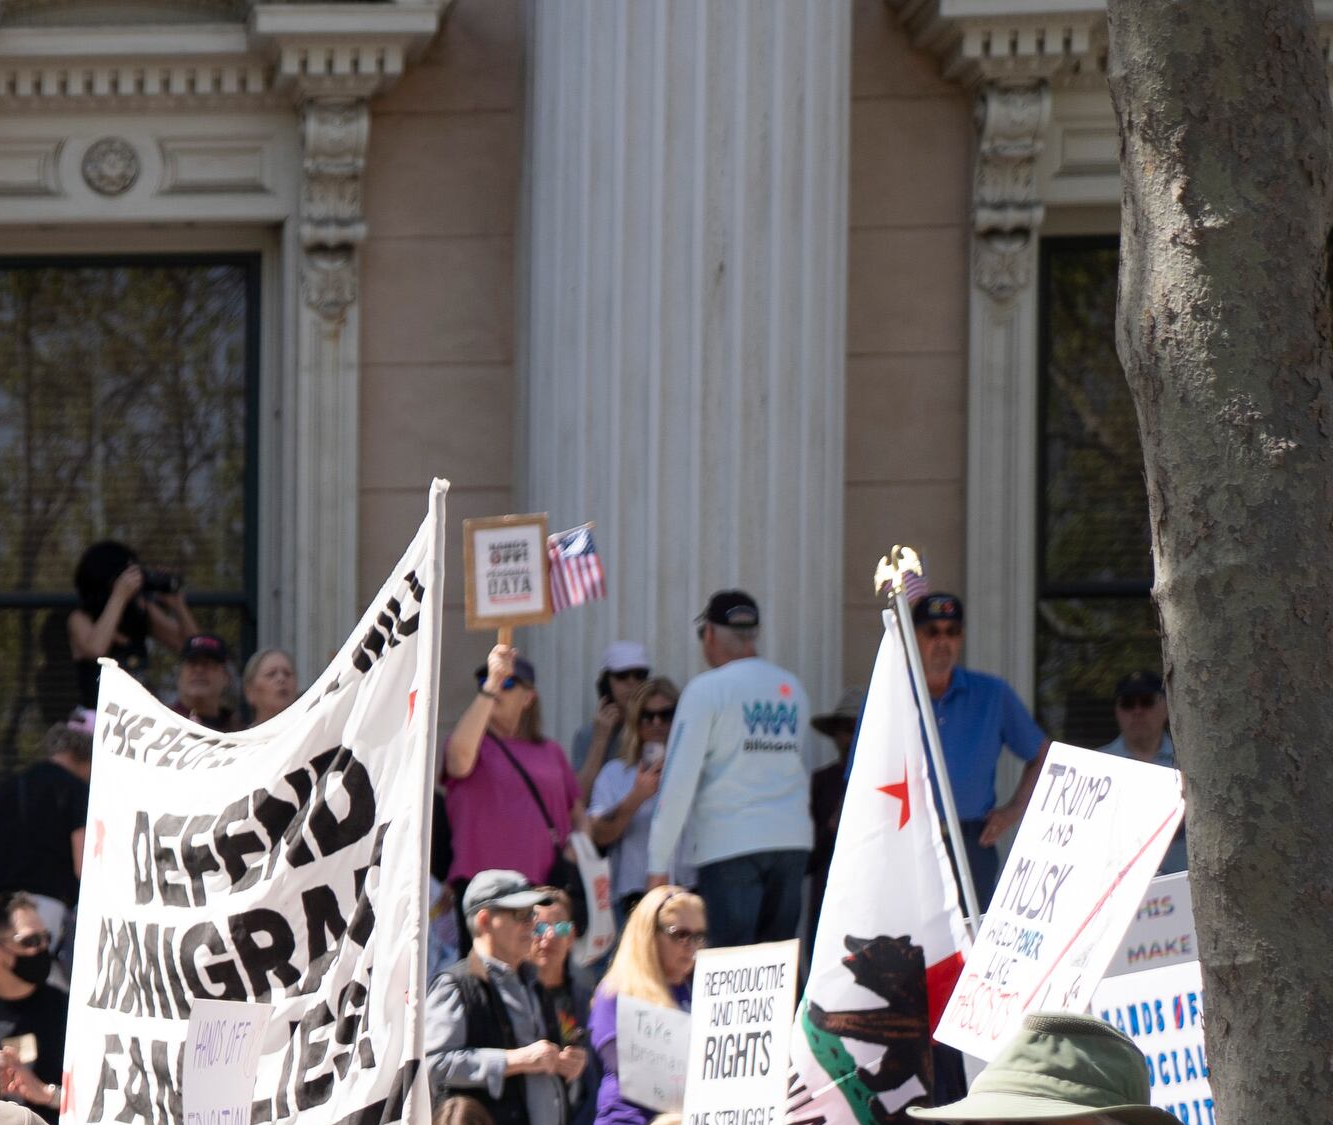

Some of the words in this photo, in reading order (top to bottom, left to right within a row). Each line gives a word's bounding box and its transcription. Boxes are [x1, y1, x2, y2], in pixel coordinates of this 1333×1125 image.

[488, 576, 532, 596] DATA
[102, 702, 157, 760] THE
[1040, 763, 1113, 820] TRUMP
[132, 745, 376, 909] DEFEND
[1041, 821, 1074, 848] AND
[999, 856, 1075, 924] MUSK
[984, 951, 1018, 986] LIKE
[1126, 932, 1193, 967] MAKE
[704, 962, 786, 998] REPRODUCTIVE
[710, 1000, 733, 1028] AND
[736, 996, 775, 1025] TRANS
[195, 1018, 228, 1070] HANDS
[702, 1030, 772, 1081] RIGHTS
